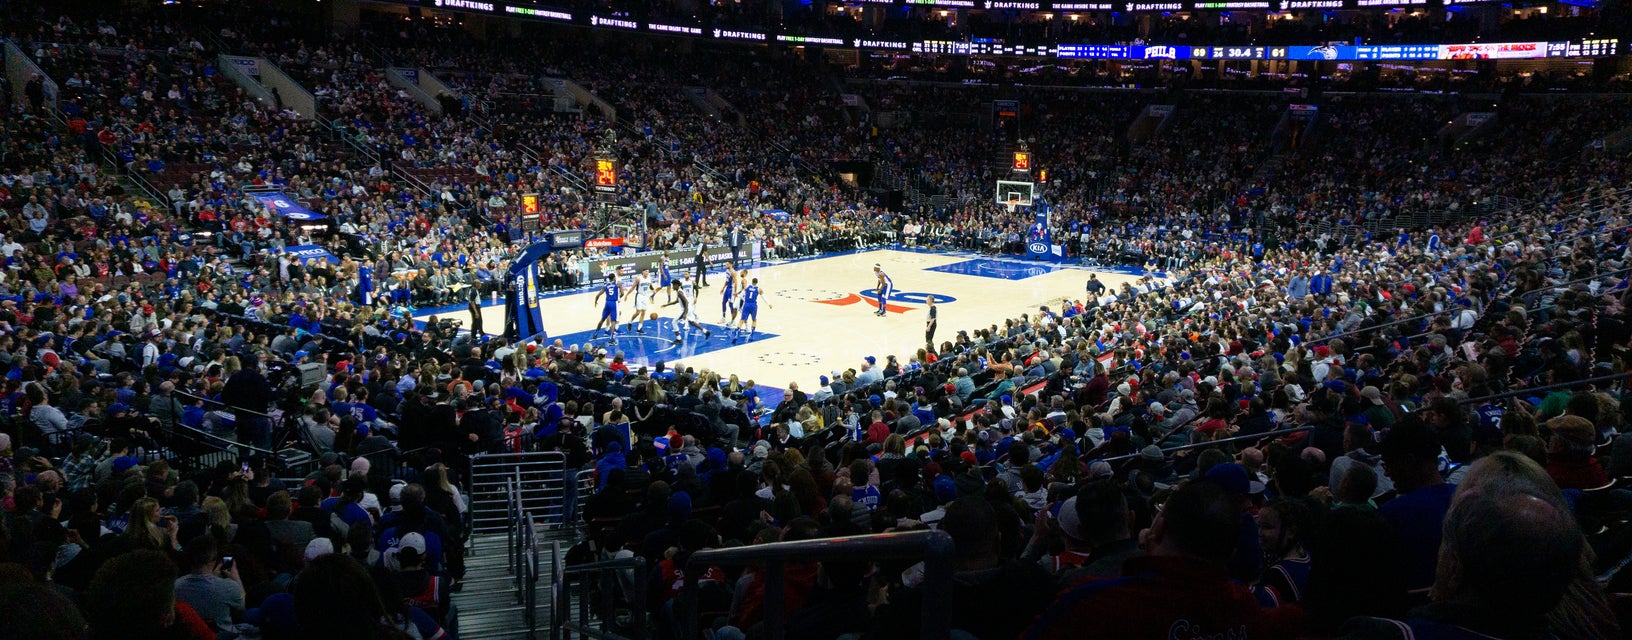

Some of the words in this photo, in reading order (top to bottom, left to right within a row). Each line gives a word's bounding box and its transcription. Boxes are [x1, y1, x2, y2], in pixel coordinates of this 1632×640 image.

[445, 0, 494, 11] DRAFTKINGS
[599, 18, 637, 28] DRAFTKINGS
[723, 30, 766, 40] DRAFTKINGS
[1144, 46, 1176, 59] PHILA
[1193, 48, 1206, 57] 69
[1229, 48, 1251, 57] 30.4
[1272, 48, 1285, 57] 61
[600, 170, 614, 184] 24
[526, 204, 535, 213] 24
[718, 250, 747, 260] BASKEALL
[608, 287, 614, 296] 5
